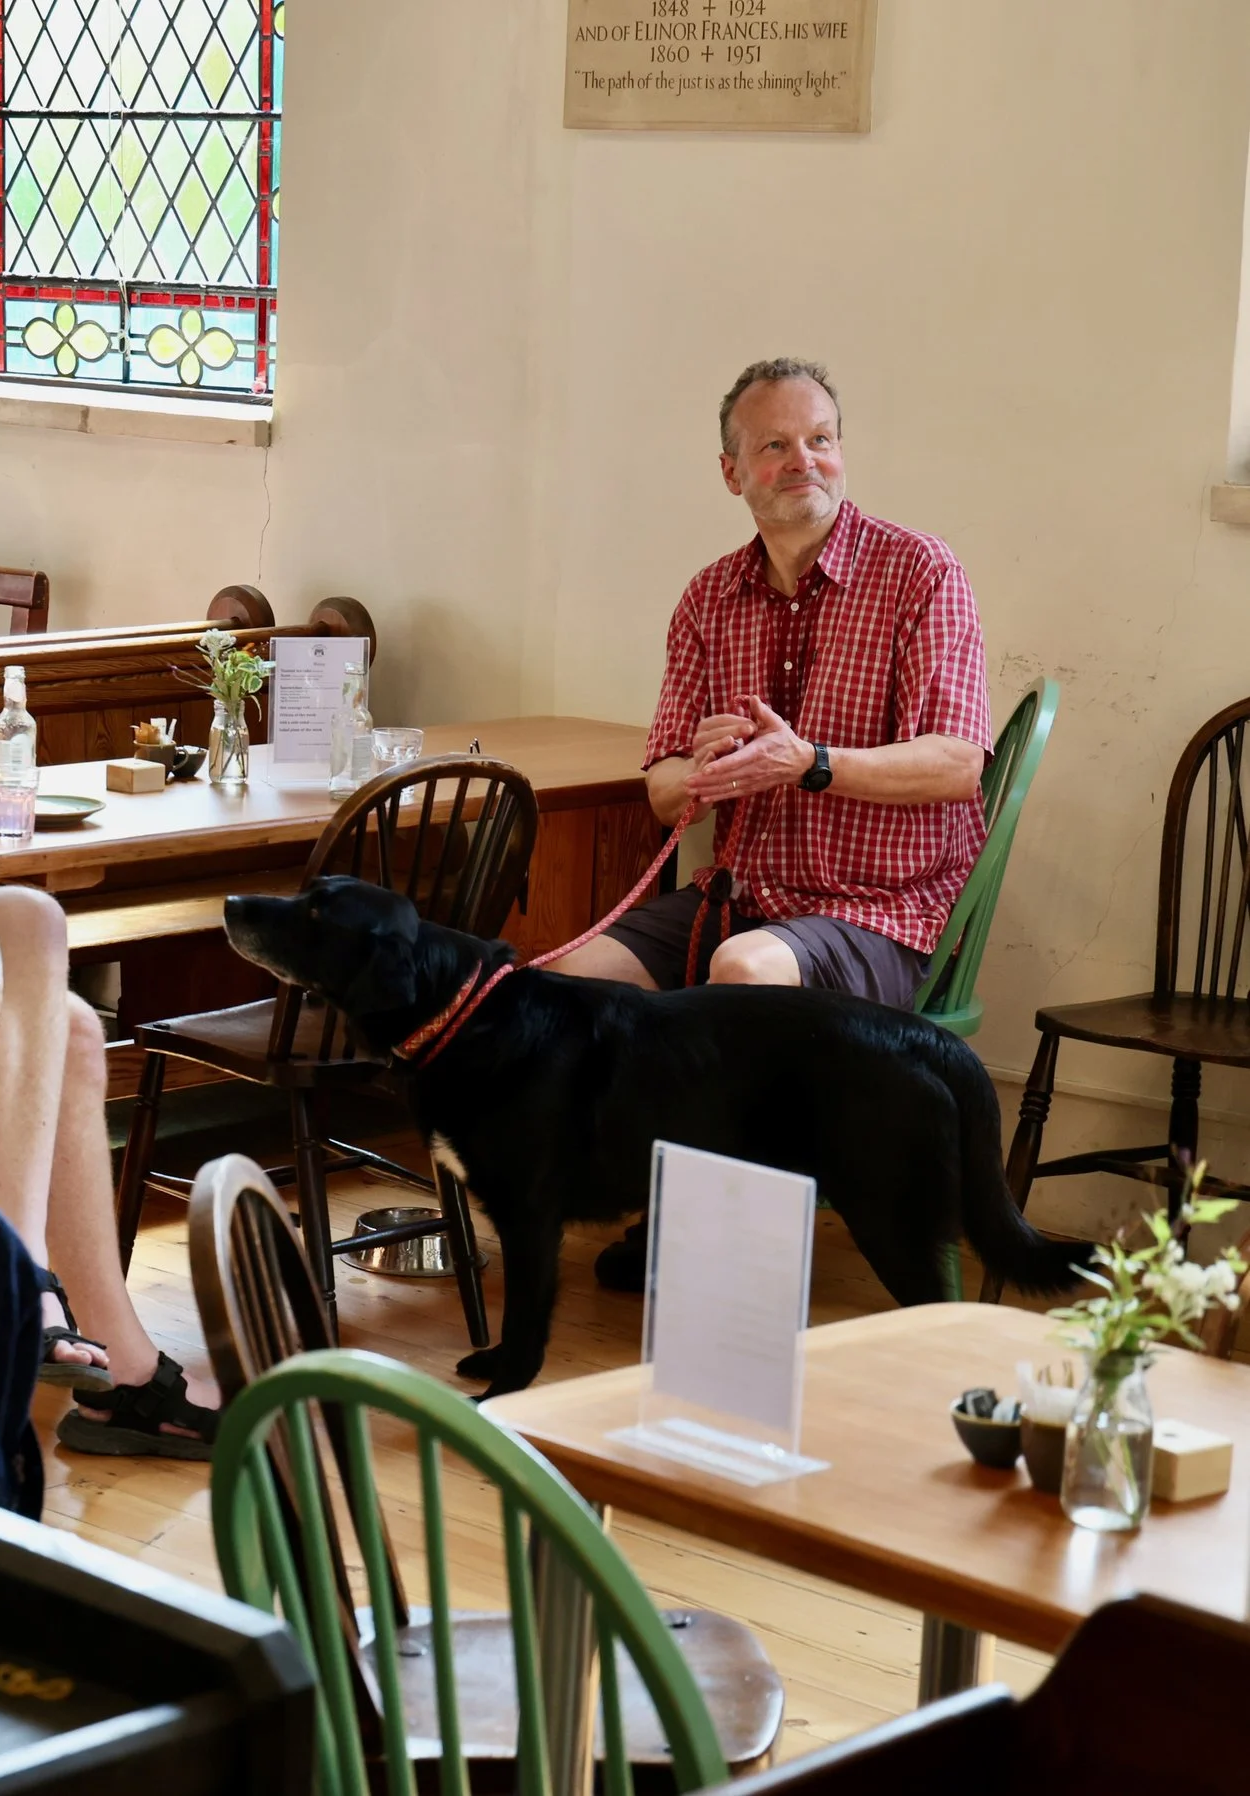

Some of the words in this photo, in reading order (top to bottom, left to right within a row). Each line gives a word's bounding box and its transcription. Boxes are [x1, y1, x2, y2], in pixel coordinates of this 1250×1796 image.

[652, 0, 689, 17] 1848
[729, 0, 766, 18] 1924
[575, 25, 608, 42] AND
[611, 25, 630, 42] OF
[635, 20, 697, 41] ELINOR
[784, 22, 809, 40] HIS
[812, 22, 848, 40] WIFE
[651, 44, 690, 63] 1860
[727, 45, 762, 66] 1951
[607, 70, 635, 97] path
[637, 72, 653, 89] of
[655, 70, 675, 89] the
[676, 74, 703, 97] just
[704, 74, 716, 90] is
[718, 78, 731, 90] as
[733, 70, 754, 90] the
[757, 70, 803, 98] shining
